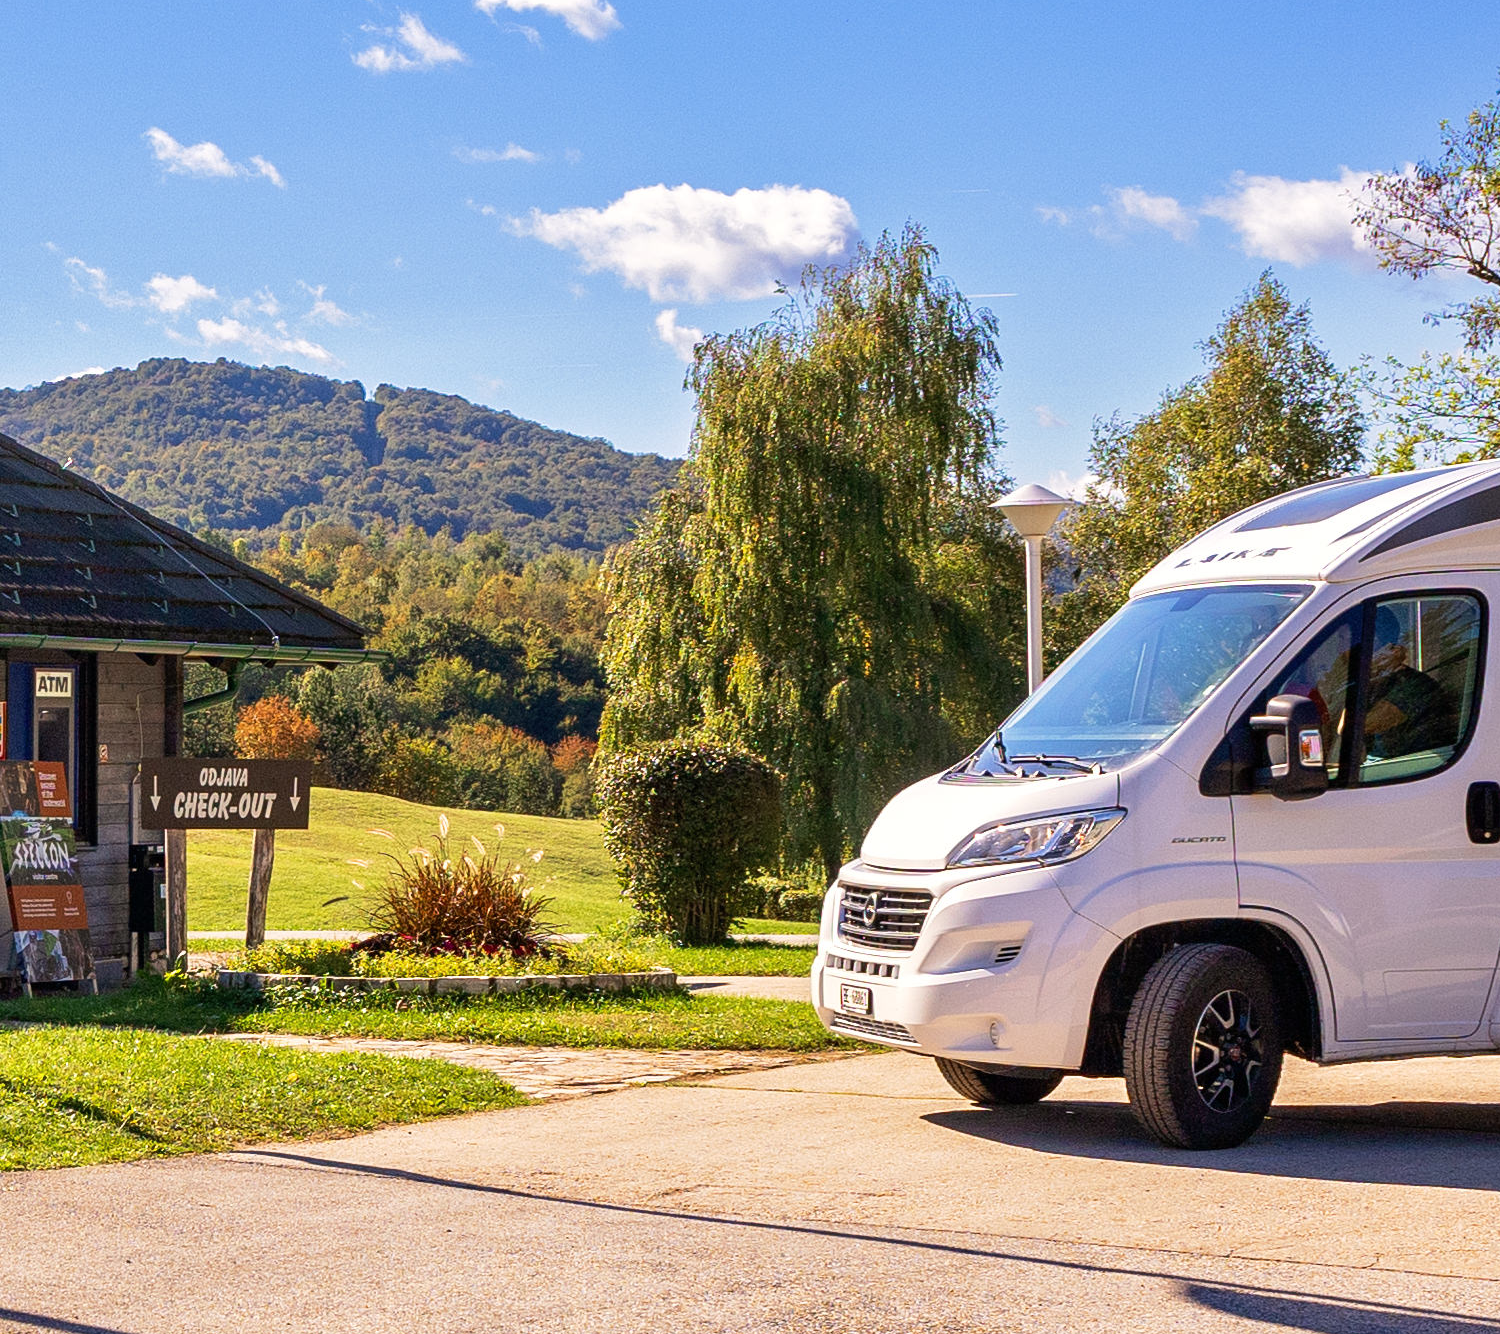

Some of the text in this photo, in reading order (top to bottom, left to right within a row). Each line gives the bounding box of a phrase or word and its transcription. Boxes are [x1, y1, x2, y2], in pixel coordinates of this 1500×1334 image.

[38, 675, 69, 693] ATM
[200, 767, 248, 787] ODJAVA
[174, 791, 278, 820] CHECK-OUT
[1171, 836, 1227, 844] DUCATO
